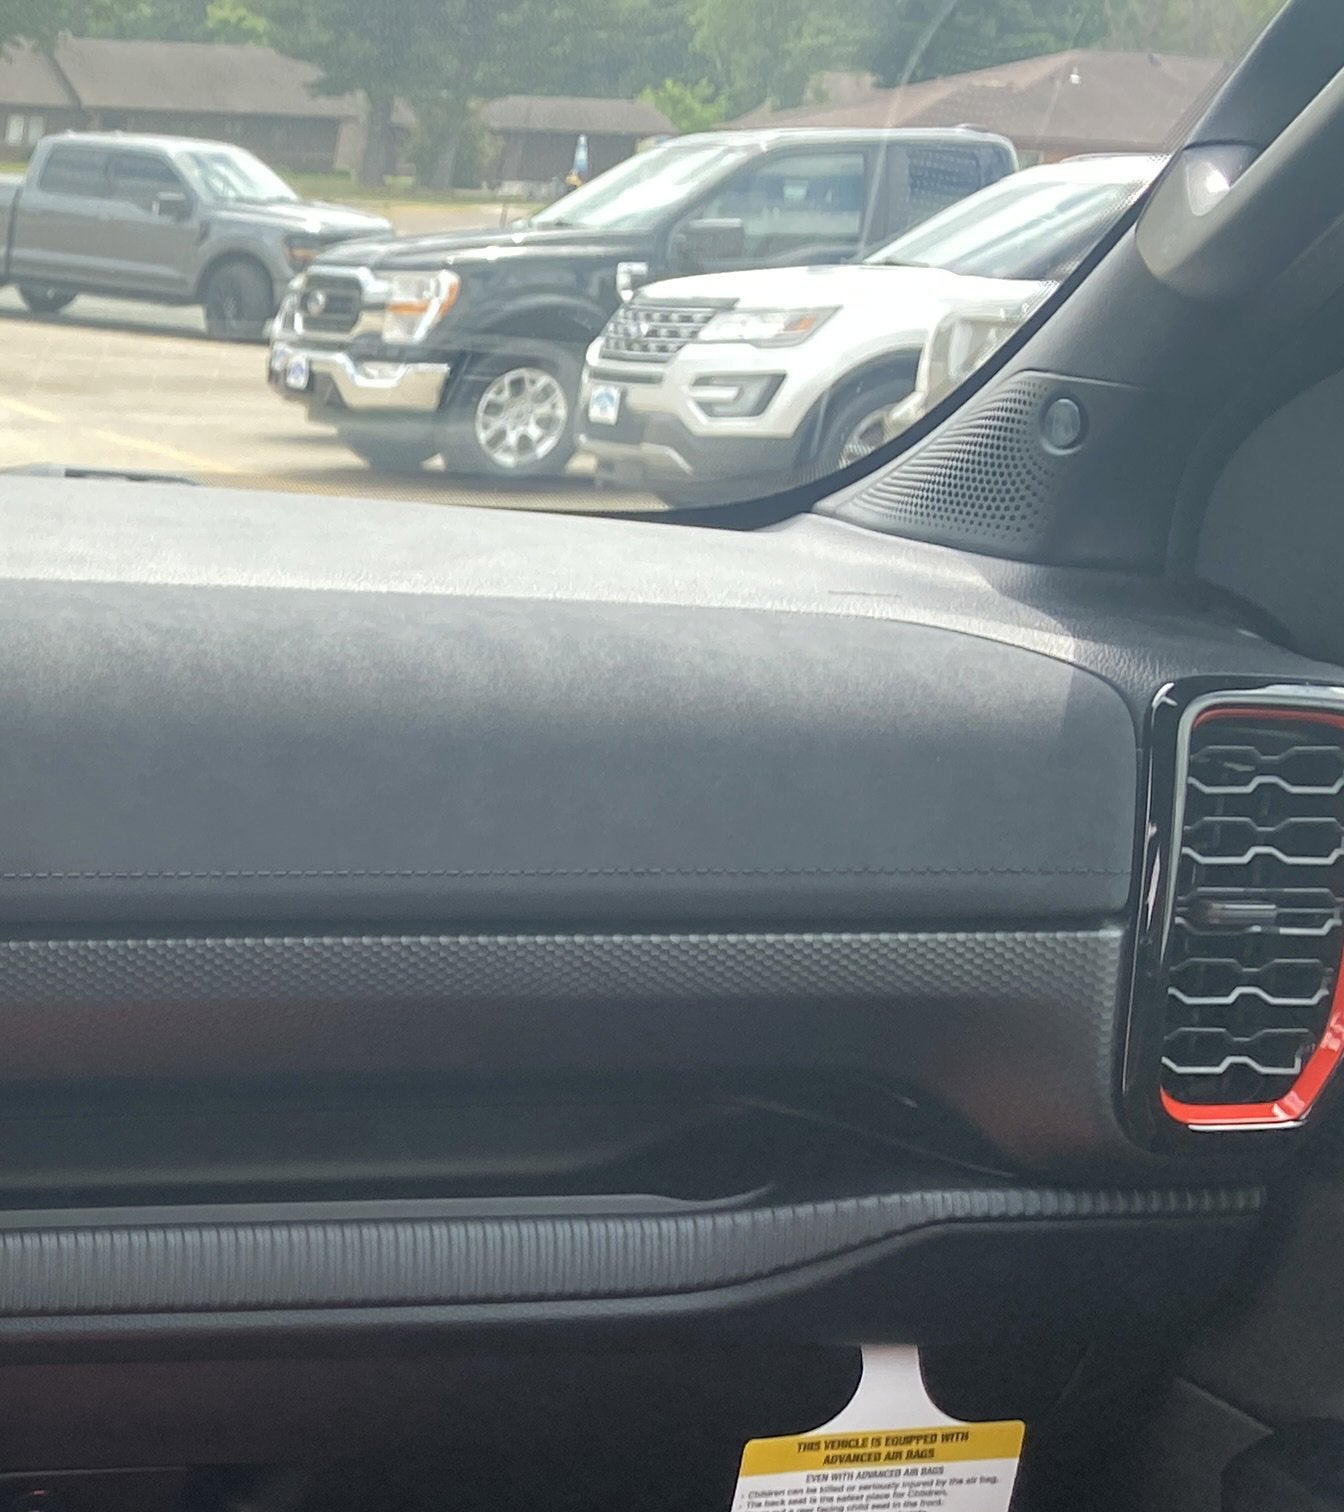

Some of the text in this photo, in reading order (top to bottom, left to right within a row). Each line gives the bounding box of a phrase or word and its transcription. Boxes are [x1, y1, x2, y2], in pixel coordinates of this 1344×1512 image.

[798, 1431, 969, 1453] THIS VEHICLE IS EQUIPPED WITH
[823, 1448, 935, 1466] ADVANCED AIR BAGS
[806, 1466, 944, 1483] EVEN WITH ADVANCED AIR BAGS
